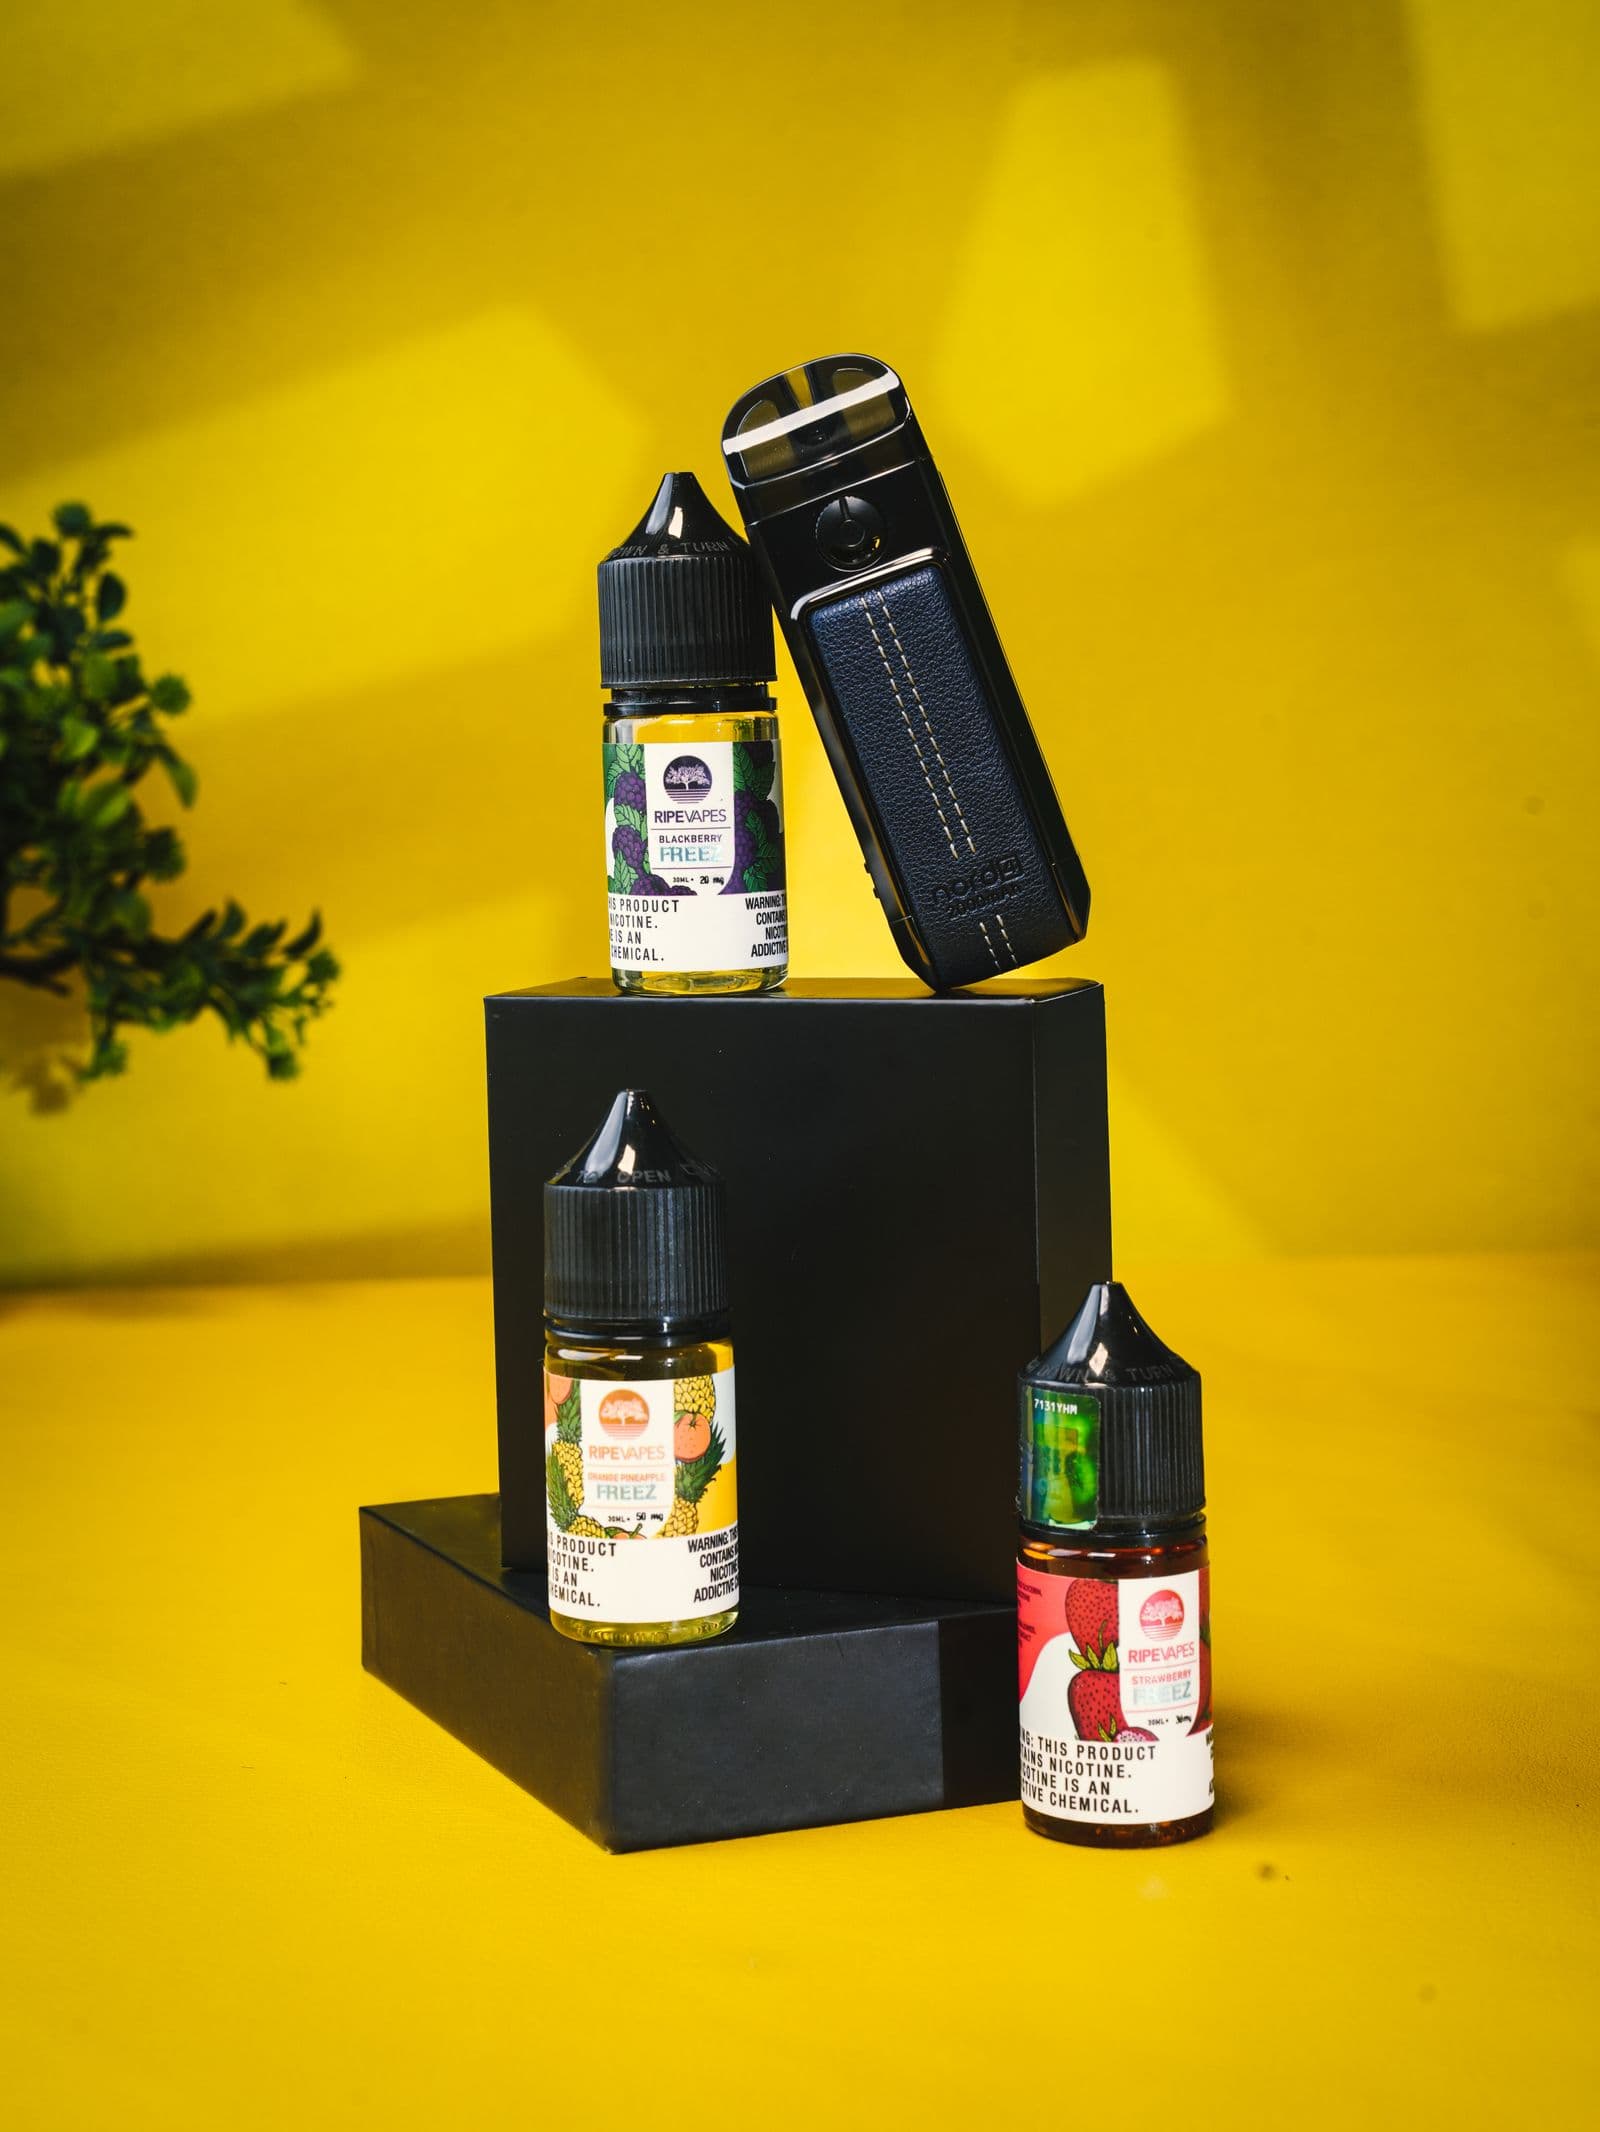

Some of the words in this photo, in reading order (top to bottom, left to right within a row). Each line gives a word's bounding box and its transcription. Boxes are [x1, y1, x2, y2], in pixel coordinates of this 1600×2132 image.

[657, 543, 670, 555] &
[680, 540, 730, 553] TURN
[654, 809, 727, 824] RIPEVAPES
[659, 834, 722, 844] BLACKBERRY
[699, 875, 709, 885] 20
[713, 876, 725, 886] mg
[620, 899, 680, 913] PRODUCT
[616, 930, 623, 944] IS
[627, 932, 642, 945] AN
[617, 1169, 672, 1184] OPEN
[1125, 1363, 1176, 1381] TURN
[1034, 1398, 1078, 1415] 7131YHM
[588, 1445, 665, 1460] RIPEVAPES
[620, 1472, 665, 1483] PINEAPPLE
[596, 1484, 657, 1500] FREEZ
[635, 1512, 647, 1521] 50
[651, 1512, 664, 1522] mg
[557, 1535, 617, 1557] PRODUCT
[563, 1571, 578, 1587] AN
[1128, 1642, 1195, 1664] RIPEVAPES
[1131, 1669, 1192, 1685] STRAWBERRY
[1037, 1736, 1068, 1757] THIS
[1077, 1745, 1156, 1761] PRODUCT
[1049, 1757, 1132, 1778] NICOTINE.
[1064, 1777, 1079, 1793] IS
[1088, 1781, 1111, 1796] AN
[1049, 1791, 1139, 1814] CHEMICAL.
